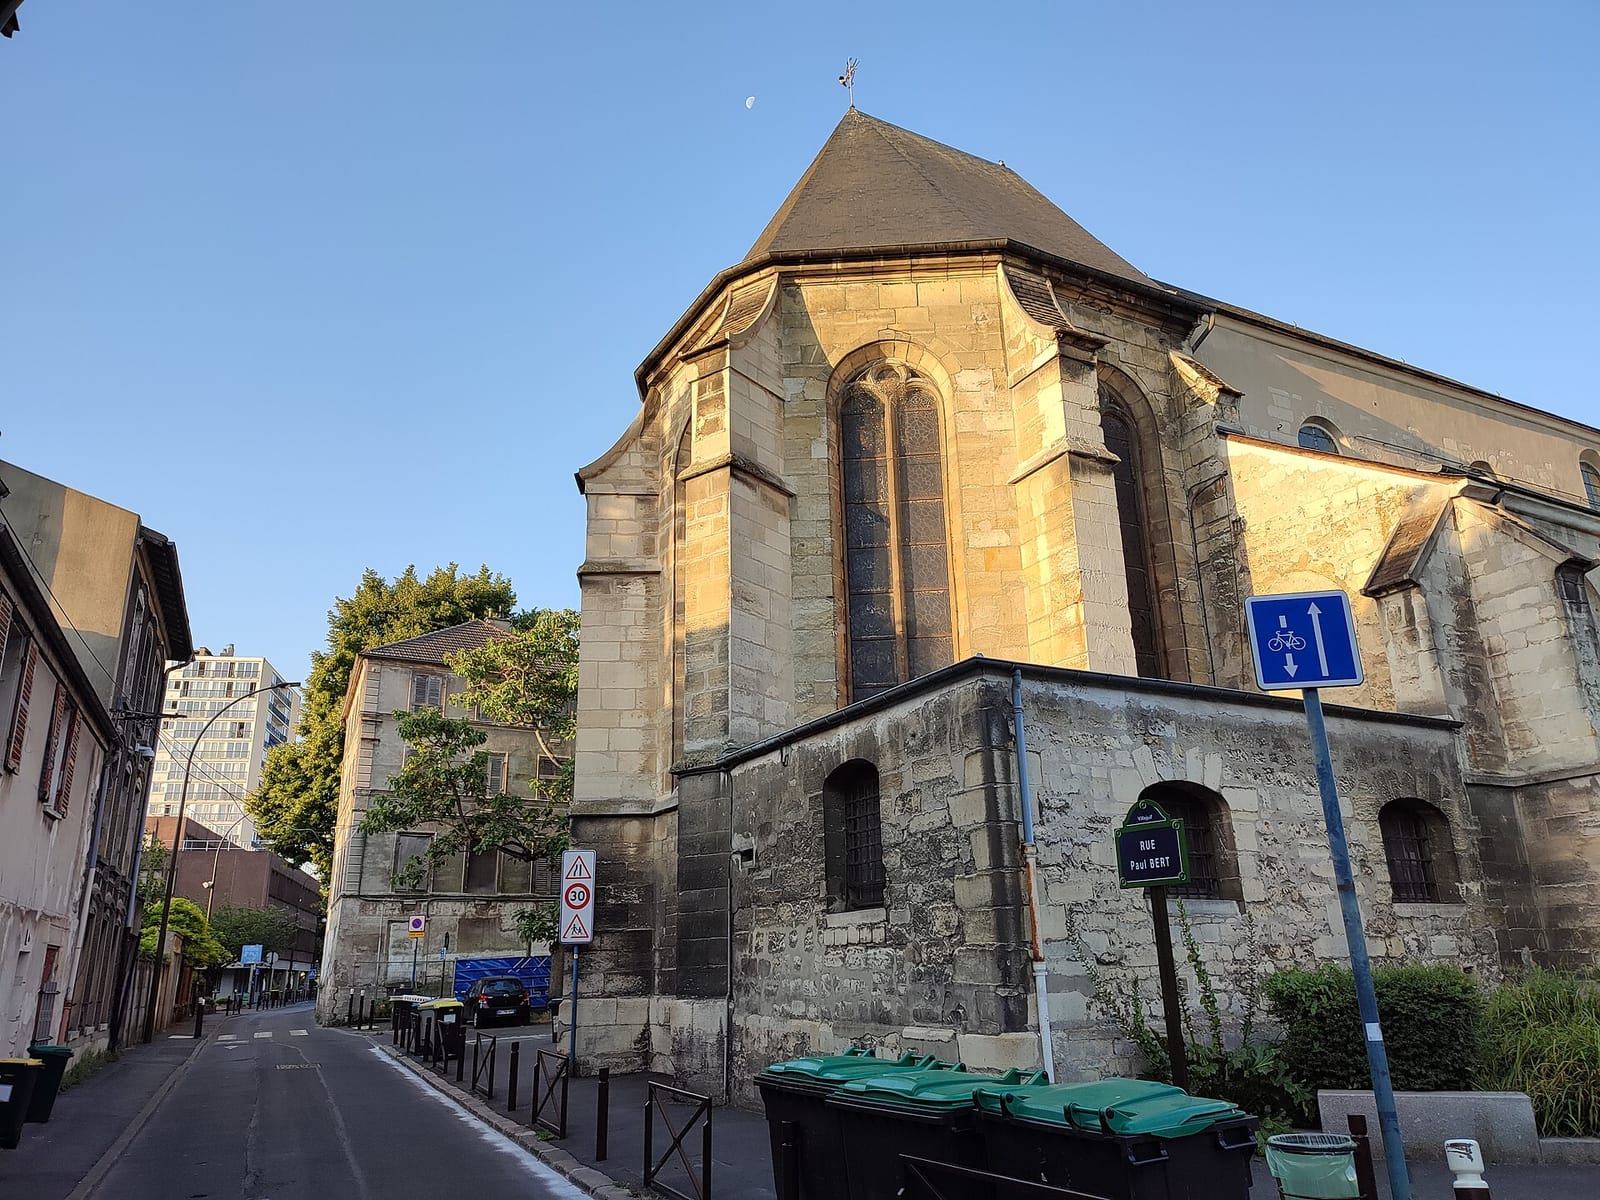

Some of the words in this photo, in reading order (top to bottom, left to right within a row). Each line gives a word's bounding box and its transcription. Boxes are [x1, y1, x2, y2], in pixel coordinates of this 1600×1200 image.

[1140, 840, 1156, 851] RUE
[1130, 859, 1147, 871] Paul
[1149, 856, 1170, 869] BERT
[570, 890, 585, 902] 30
